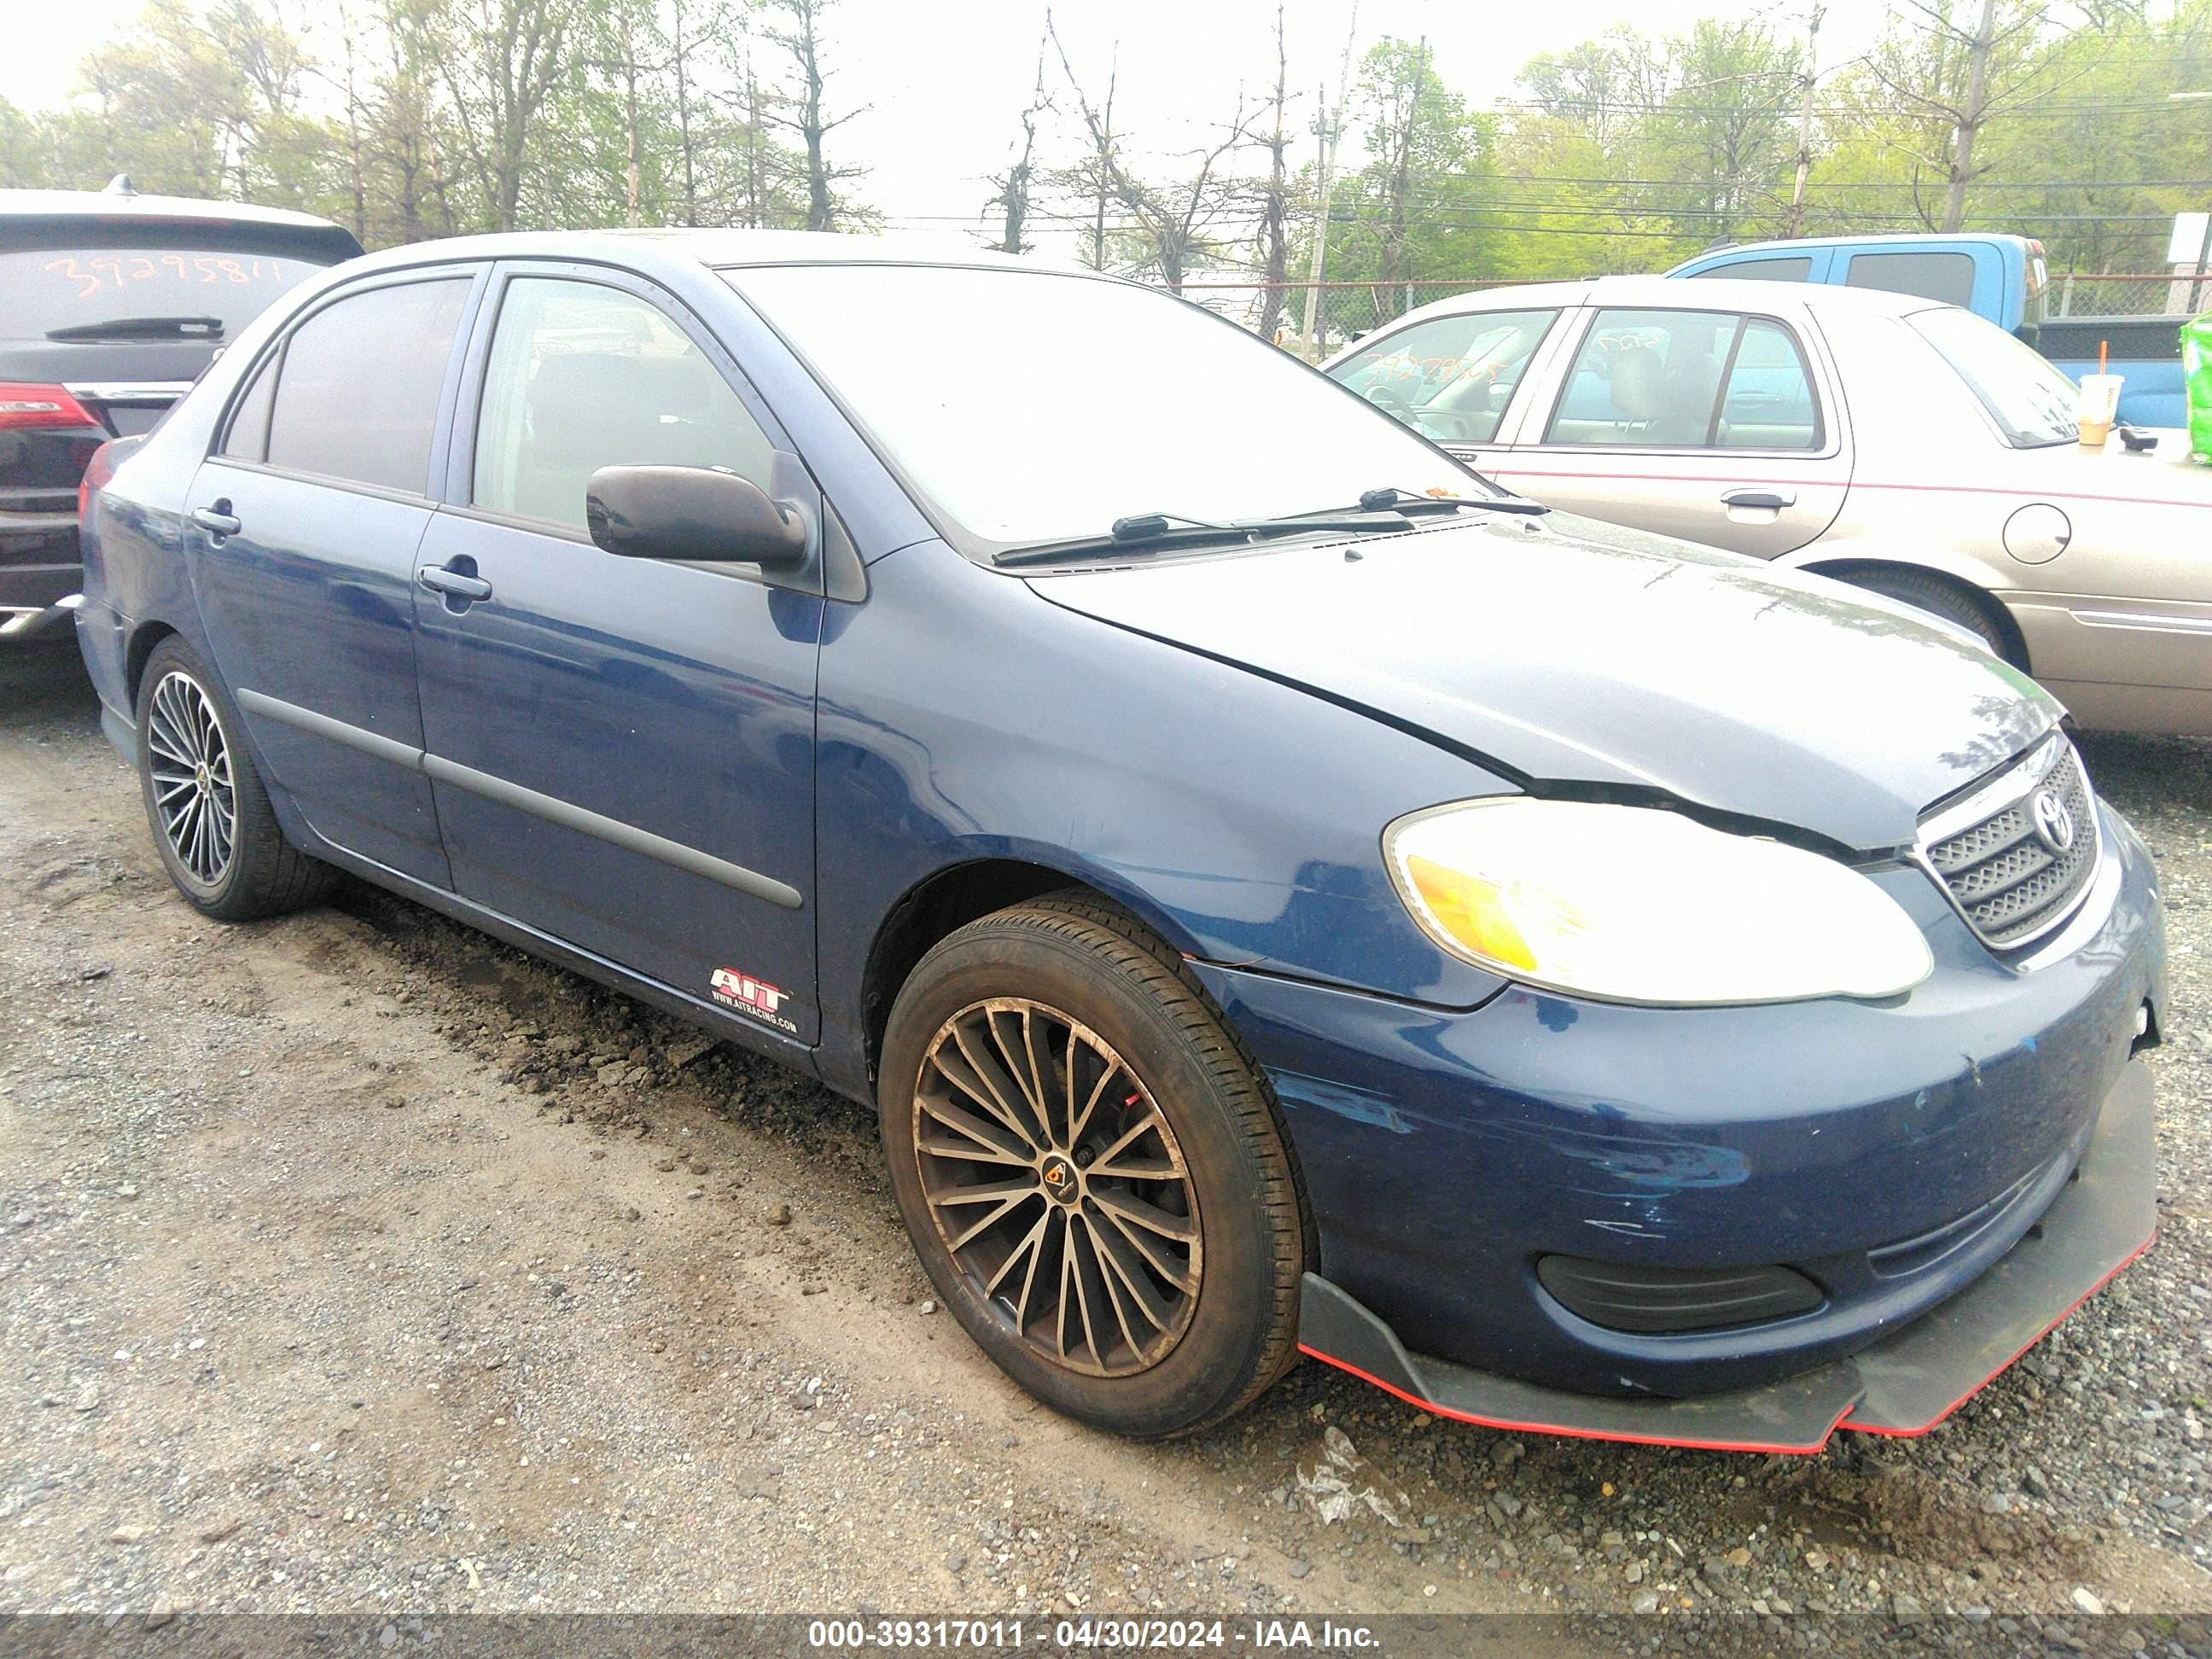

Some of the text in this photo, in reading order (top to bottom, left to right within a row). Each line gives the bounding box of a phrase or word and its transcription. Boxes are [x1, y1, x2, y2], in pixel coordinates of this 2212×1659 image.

[44, 255, 283, 299] 39295811
[710, 966, 790, 1013] AIT
[711, 990, 798, 1033] WWW.AITRACING.COM
